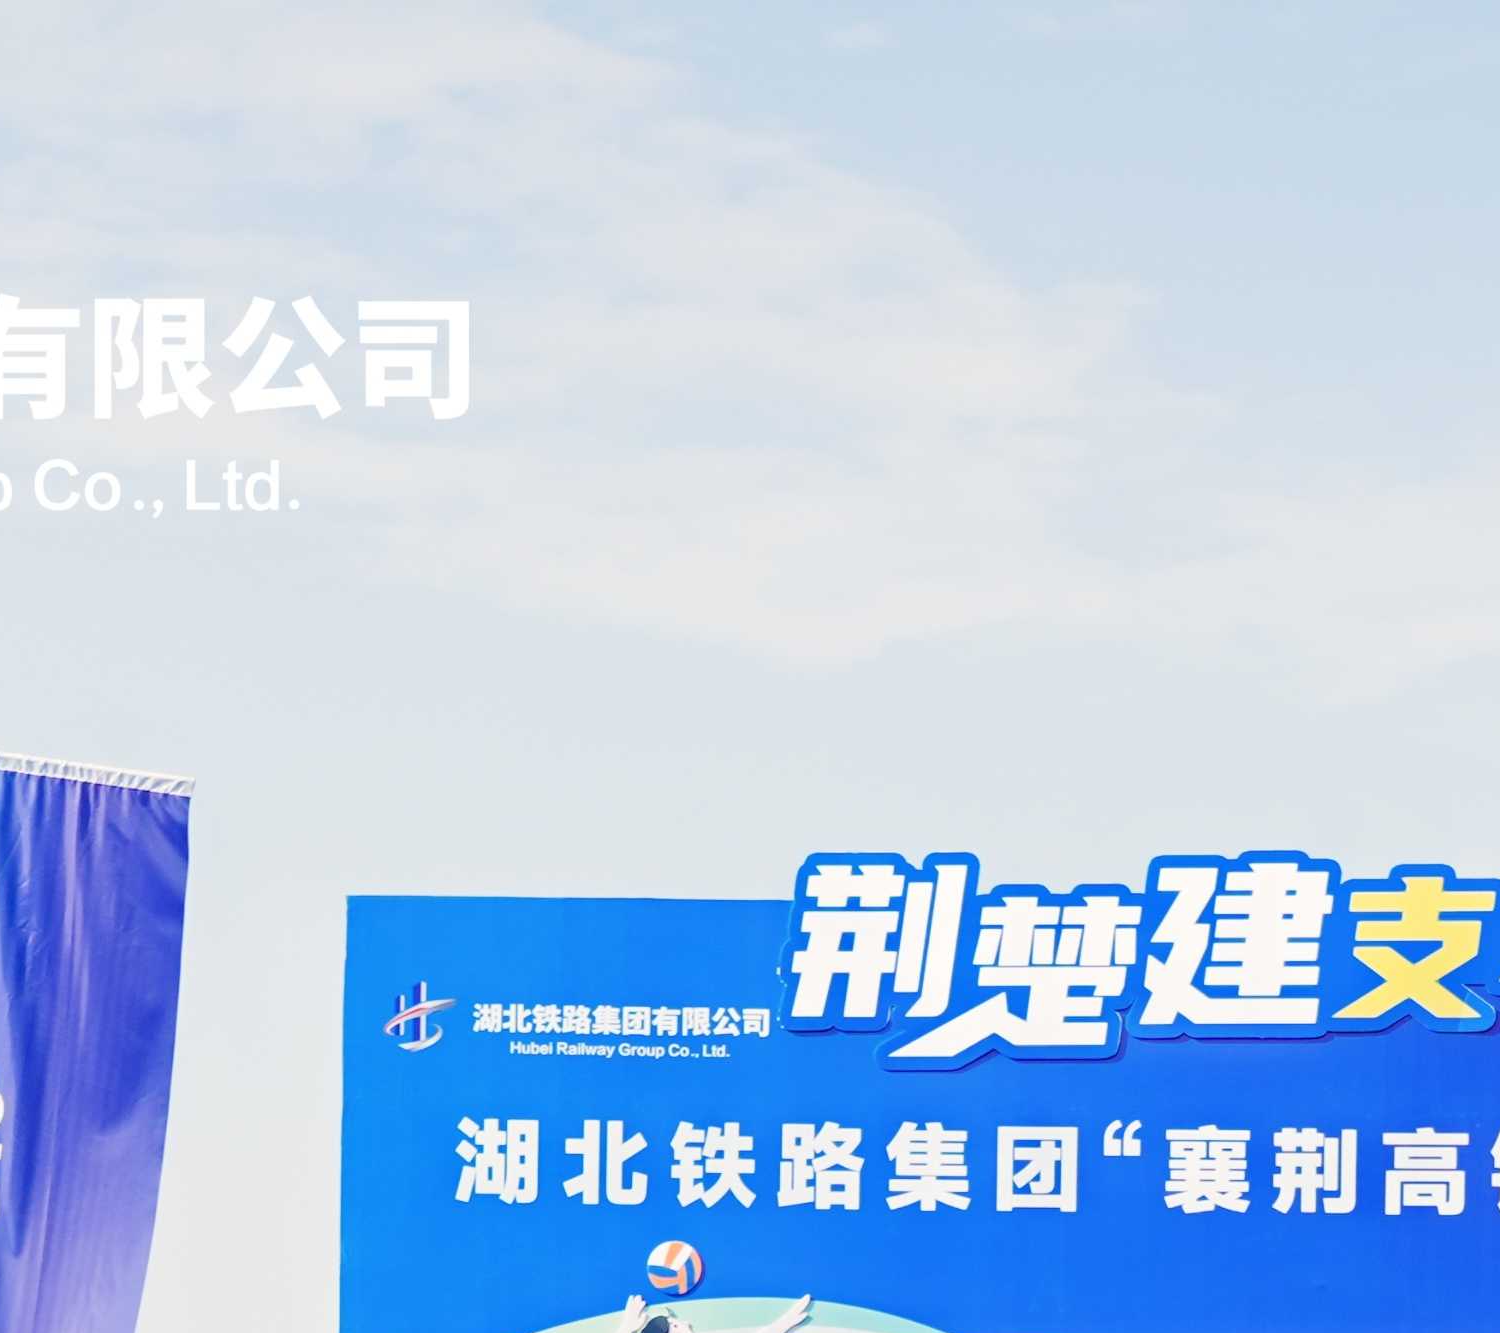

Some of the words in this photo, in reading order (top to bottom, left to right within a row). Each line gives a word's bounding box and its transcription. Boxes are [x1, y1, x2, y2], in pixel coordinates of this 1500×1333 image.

[473, 1003, 770, 1038] 湖北铁路集团有限公司
[510, 1041, 553, 1056] Hubei
[556, 1042, 615, 1059] Railway
[618, 1043, 665, 1060] Group
[702, 1044, 731, 1058] Ltd.
